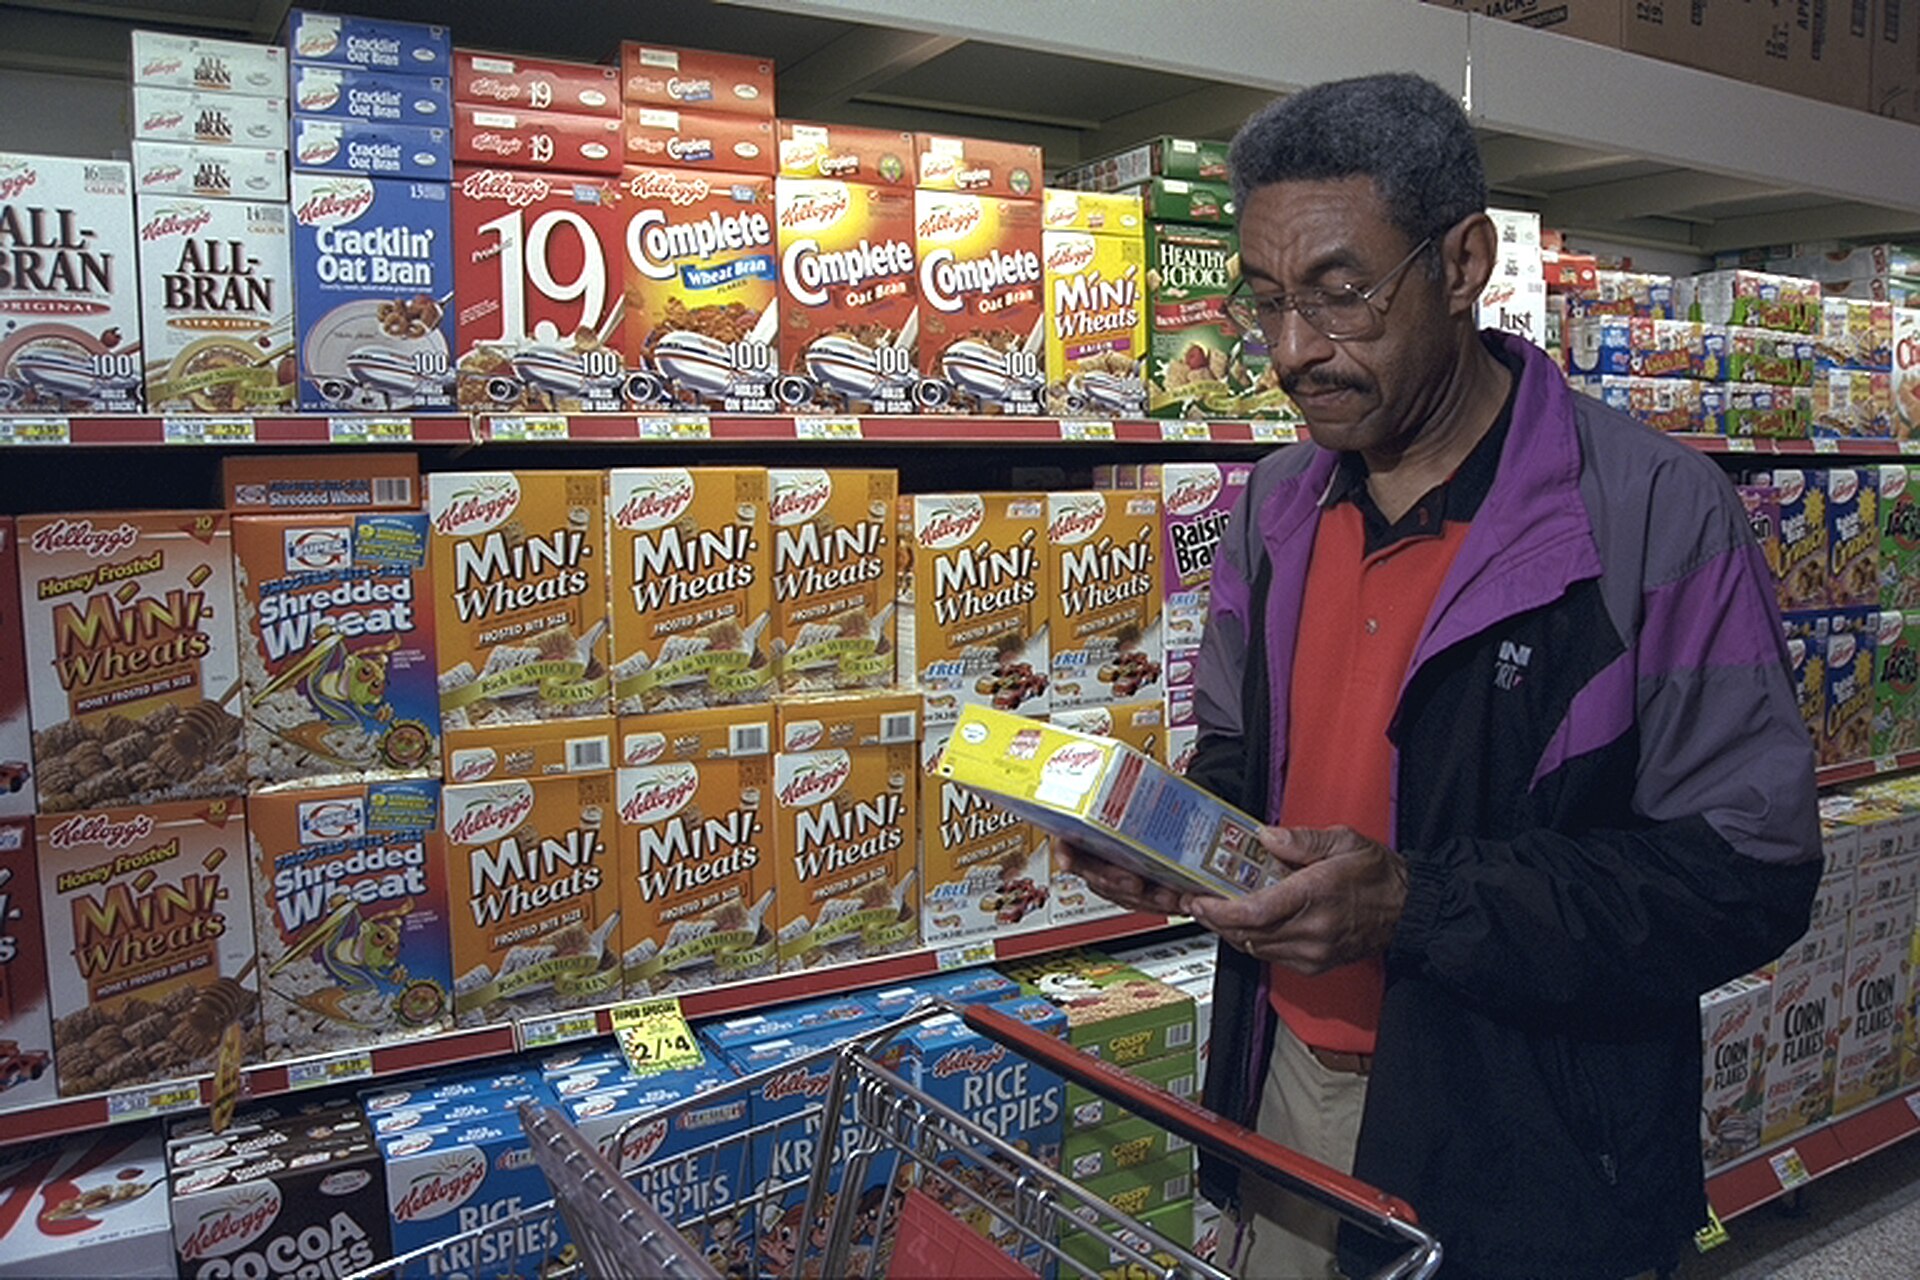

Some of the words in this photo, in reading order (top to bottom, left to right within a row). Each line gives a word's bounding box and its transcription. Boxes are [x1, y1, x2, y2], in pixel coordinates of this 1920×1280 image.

[347, 36, 400, 53] Cracklin'
[347, 51, 370, 63] Oat
[372, 52, 399, 66] Bran
[349, 89, 401, 105] Cracklin'
[349, 104, 370, 116] Oat
[372, 105, 400, 118] Bran
[527, 81, 552, 109] 19
[348, 142, 401, 158] Cracklin'
[348, 156, 370, 169] Oat
[372, 158, 400, 171] Bran
[528, 134, 553, 162] 19
[463, 169, 550, 206] Kellogg's
[631, 171, 710, 205] Kellogg's
[297, 189, 370, 224] Kellogg's
[780, 199, 846, 228] Kellogg's
[918, 208, 980, 238] Kellogg's
[142, 210, 211, 241] Kellogg's
[316, 225, 434, 258] Cracklin'
[176, 238, 260, 275] ALL-
[472, 238, 513, 263] Product
[626, 209, 771, 279] Complete
[1047, 246, 1094, 269] Kellogg's
[1160, 243, 1228, 268] HEALTHY
[316, 256, 368, 283] Oat
[372, 258, 432, 285] Bran
[687, 265, 733, 286] Wheat
[735, 258, 766, 276] Bran
[782, 239, 914, 307] Complete
[920, 248, 1040, 312] Complete
[1161, 265, 1228, 288] CHOICE
[162, 274, 275, 312] BRAN
[846, 290, 873, 307] Oat
[876, 280, 907, 298] Bran
[978, 298, 1003, 314] Oat
[1005, 288, 1034, 306] Bran
[1055, 306, 1139, 340] Wheats
[1500, 306, 1532, 332] Just
[92, 353, 131, 376] 100
[414, 353, 448, 374] 100
[581, 352, 617, 376] 100
[729, 341, 768, 370] 100
[874, 348, 909, 374] 100
[1003, 352, 1036, 378] 100
[269, 492, 328, 506] Shredded
[330, 491, 370, 504] Wheat
[437, 488, 518, 533] Kellogg's
[616, 484, 691, 527] Kellogg's
[1167, 479, 1220, 513] Kellogg's
[33, 520, 137, 557] Kellogg's
[195, 516, 213, 529] 10
[919, 508, 982, 547] Kellogg's
[1049, 508, 1104, 542] Kellogg's
[38, 572, 95, 600] Honey
[98, 549, 163, 585] Frosted
[629, 564, 755, 614] Wheats
[772, 558, 883, 603] Wheats
[259, 578, 412, 625] Shredded
[452, 570, 589, 622] Wheats
[933, 581, 1036, 625] Wheats
[1060, 575, 1150, 618] Wheats
[261, 602, 415, 662] Wheat
[479, 624, 523, 644] FROSTED
[525, 620, 544, 634] BITE
[546, 612, 568, 627] SIZE
[51, 633, 210, 691] Wheats
[928, 661, 964, 676] FREE
[546, 685, 595, 700] GRAIN
[622, 774, 696, 822] Kellogg's
[780, 761, 849, 806] Kellogg's
[50, 814, 154, 850] Kellogg's
[451, 794, 532, 843] Kellogg's
[58, 863, 113, 894] Honey
[116, 838, 180, 874] Frosted
[274, 843, 425, 898] Shredded
[793, 825, 904, 883] Wheats
[636, 843, 760, 903] Wheats
[277, 867, 427, 933] Wheat
[468, 864, 603, 928] Wheats
[70, 914, 226, 978] Wheats
[1856, 974, 1896, 1012] CORN
[1784, 997, 1826, 1039] CORN
[1854, 1006, 1893, 1039] FLAKES
[1109, 1030, 1153, 1052] CRISPY
[1115, 1044, 1146, 1061] RICE
[1714, 1038, 1749, 1070] CORN
[1782, 1030, 1824, 1066] FLAKES
[932, 1043, 1006, 1078] Kellogg's
[1713, 1063, 1748, 1090] FLAKES
[964, 1062, 1029, 1111] RICE
[1111, 1136, 1155, 1158] CRISPY
[1117, 1150, 1147, 1168] RICE
[394, 1161, 484, 1221] Kellogg's
[642, 1157, 699, 1193] RICE
[1109, 1185, 1152, 1207] CRISPY
[181, 1196, 279, 1257] Kellogg's
[459, 1197, 521, 1233] RICE
[196, 1211, 366, 1280] COCOA
[428, 1217, 558, 1274] KRISPIES
